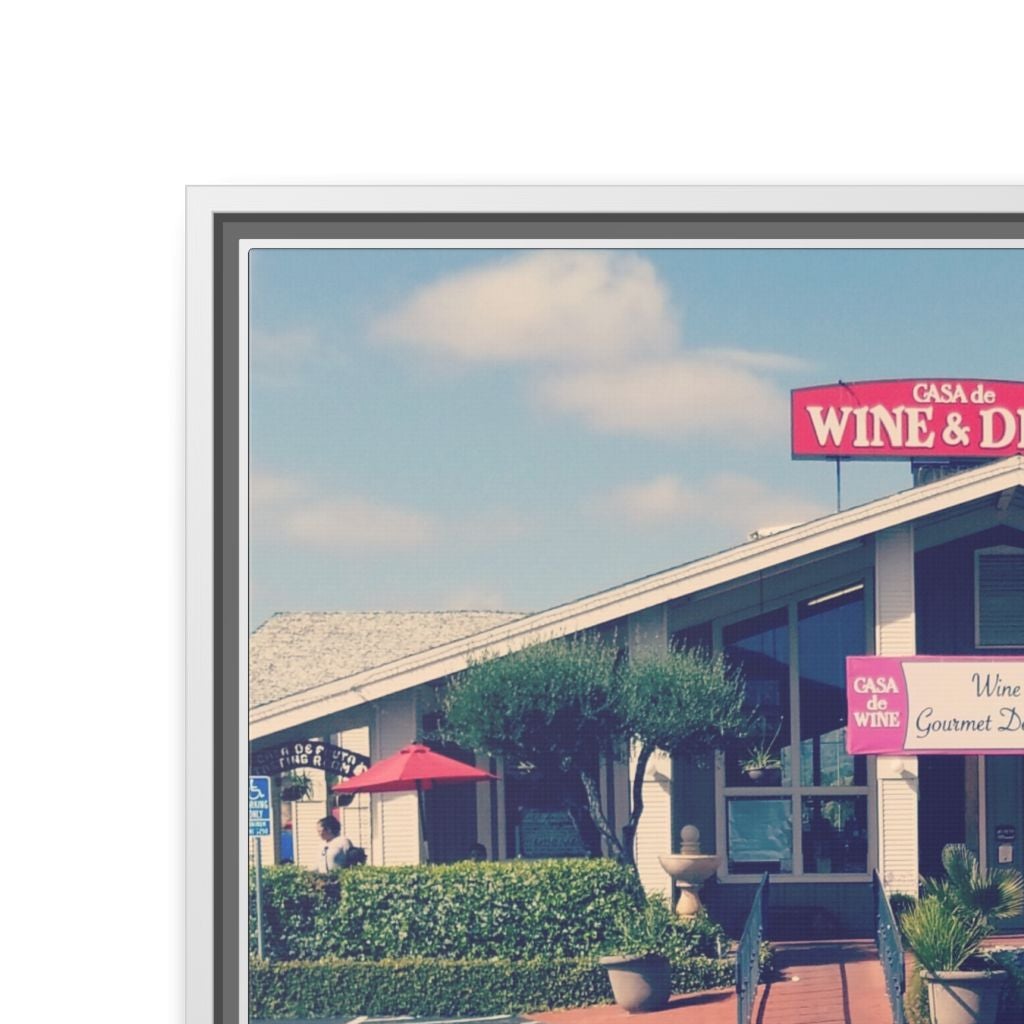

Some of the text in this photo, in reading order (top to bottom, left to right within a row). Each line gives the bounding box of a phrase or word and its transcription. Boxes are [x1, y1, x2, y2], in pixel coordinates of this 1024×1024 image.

[913, 383, 996, 404] CASA de
[807, 404, 936, 449] WINE
[942, 412, 971, 447] &
[853, 677, 899, 694] CASA
[971, 673, 1021, 698] Wine
[866, 694, 888, 711] de
[853, 711, 901, 729] WINE
[916, 707, 992, 738] Gourmet
[315, 744, 357, 765] FUTA
